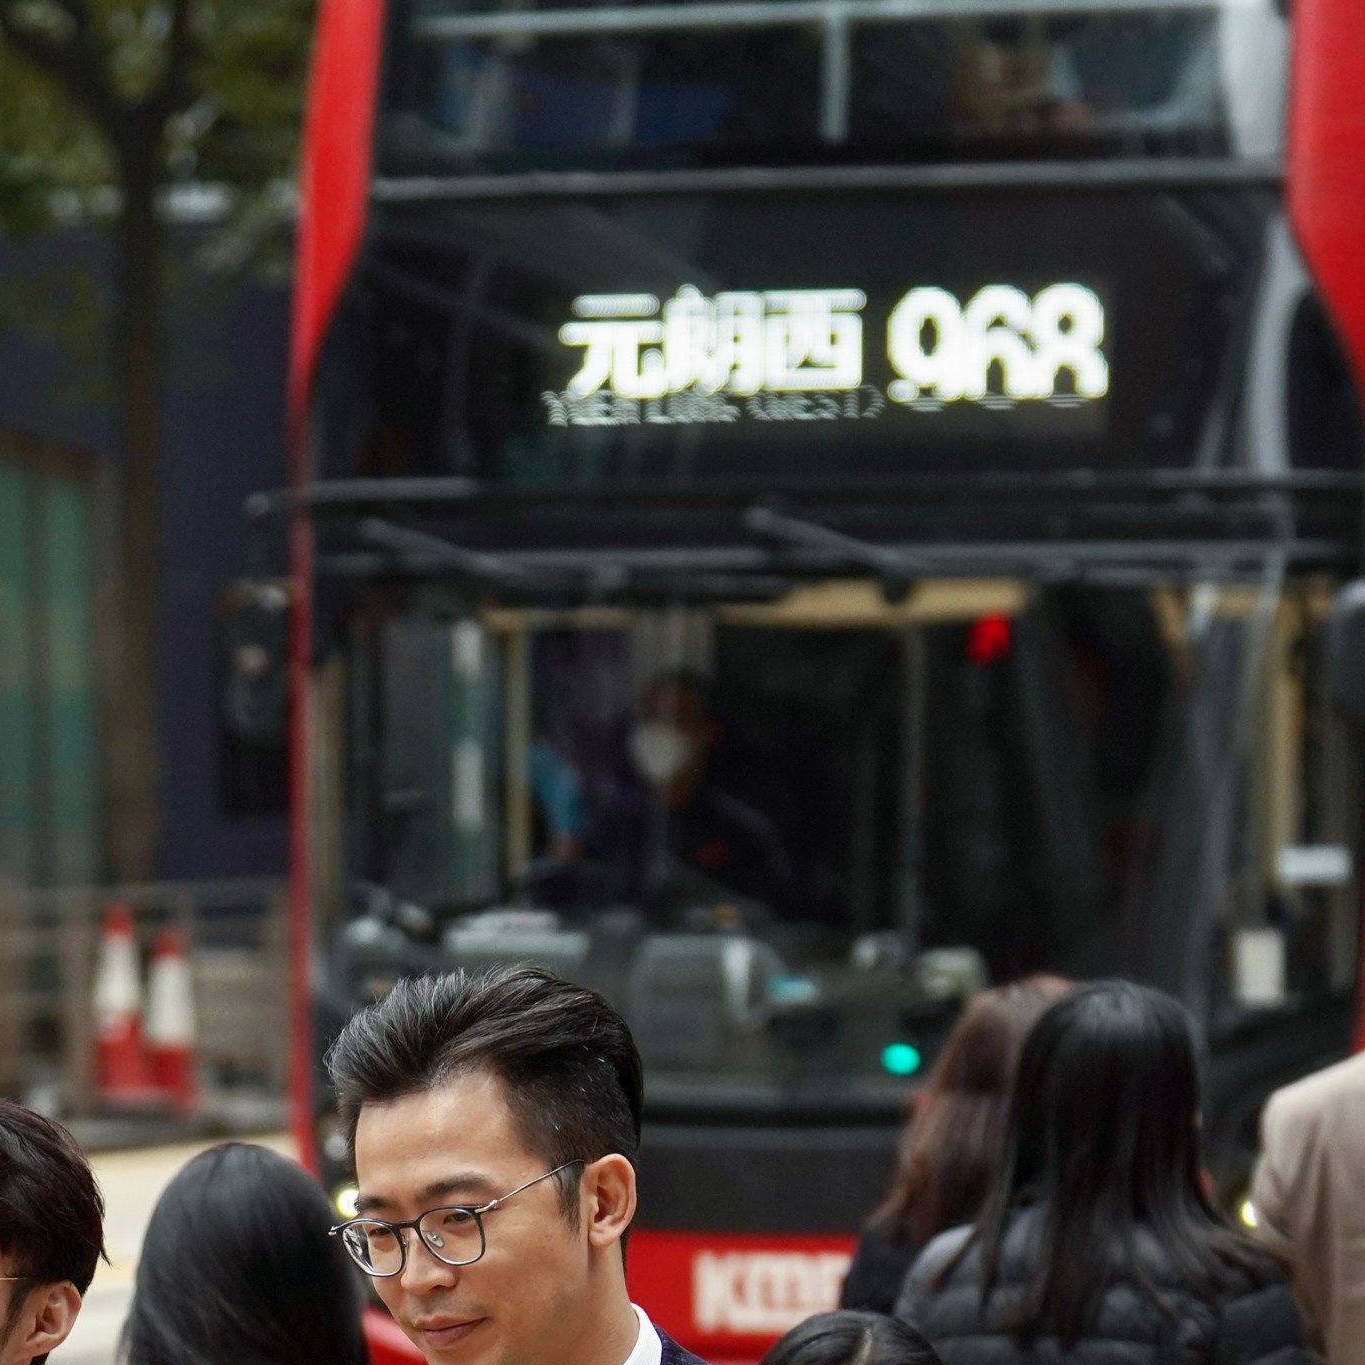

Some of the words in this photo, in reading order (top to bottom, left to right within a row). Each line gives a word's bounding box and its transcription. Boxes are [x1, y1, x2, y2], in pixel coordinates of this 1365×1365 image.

[557, 284, 867, 398] 元朗西
[887, 283, 1107, 401] 968
